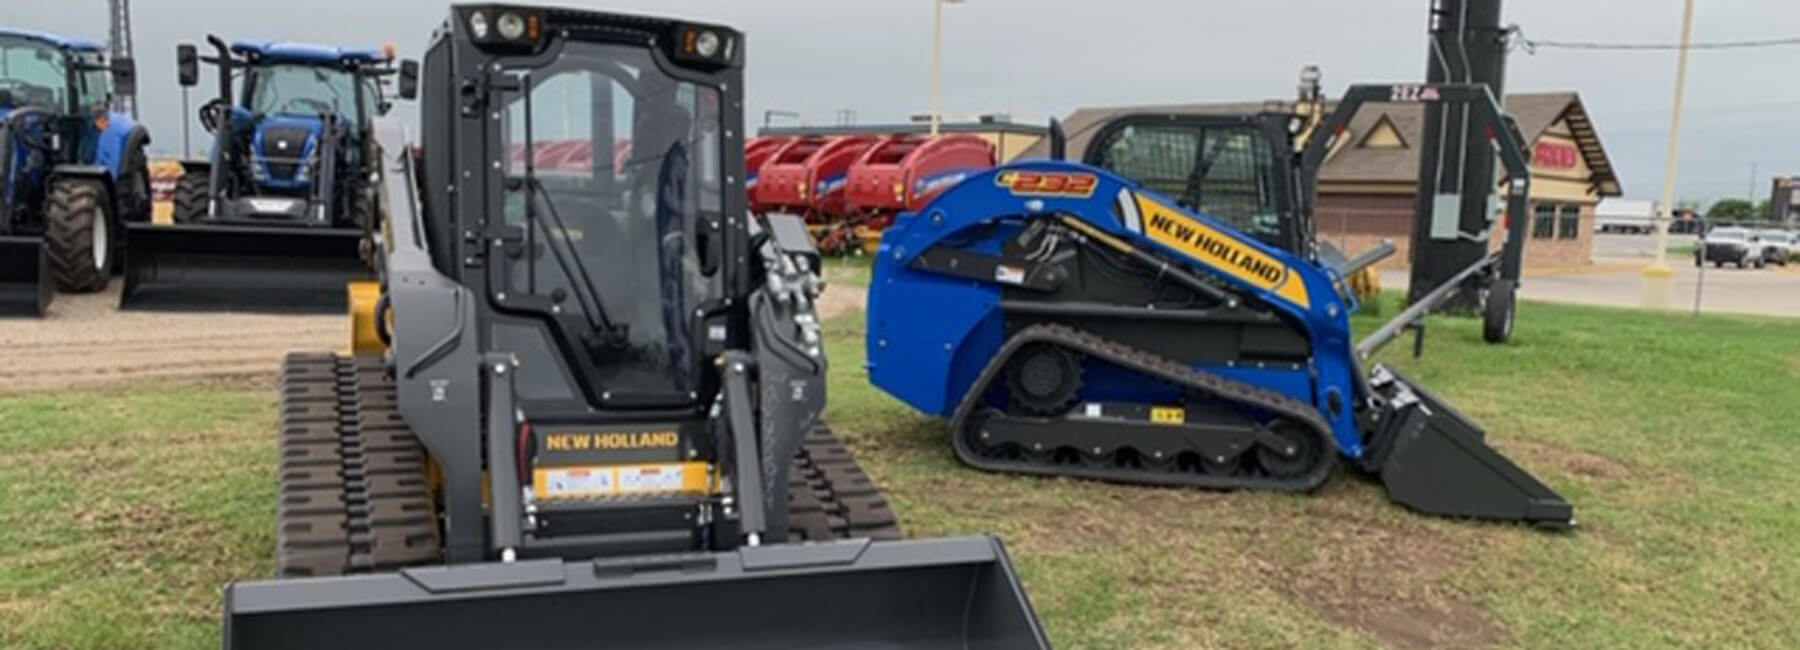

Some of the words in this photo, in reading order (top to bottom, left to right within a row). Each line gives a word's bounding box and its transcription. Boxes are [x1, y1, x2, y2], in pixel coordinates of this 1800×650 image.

[1150, 213, 1195, 241] NEW
[1194, 234, 1281, 284] HOLLAND
[546, 433, 591, 450] NEW
[594, 432, 679, 448] HOLLAND
